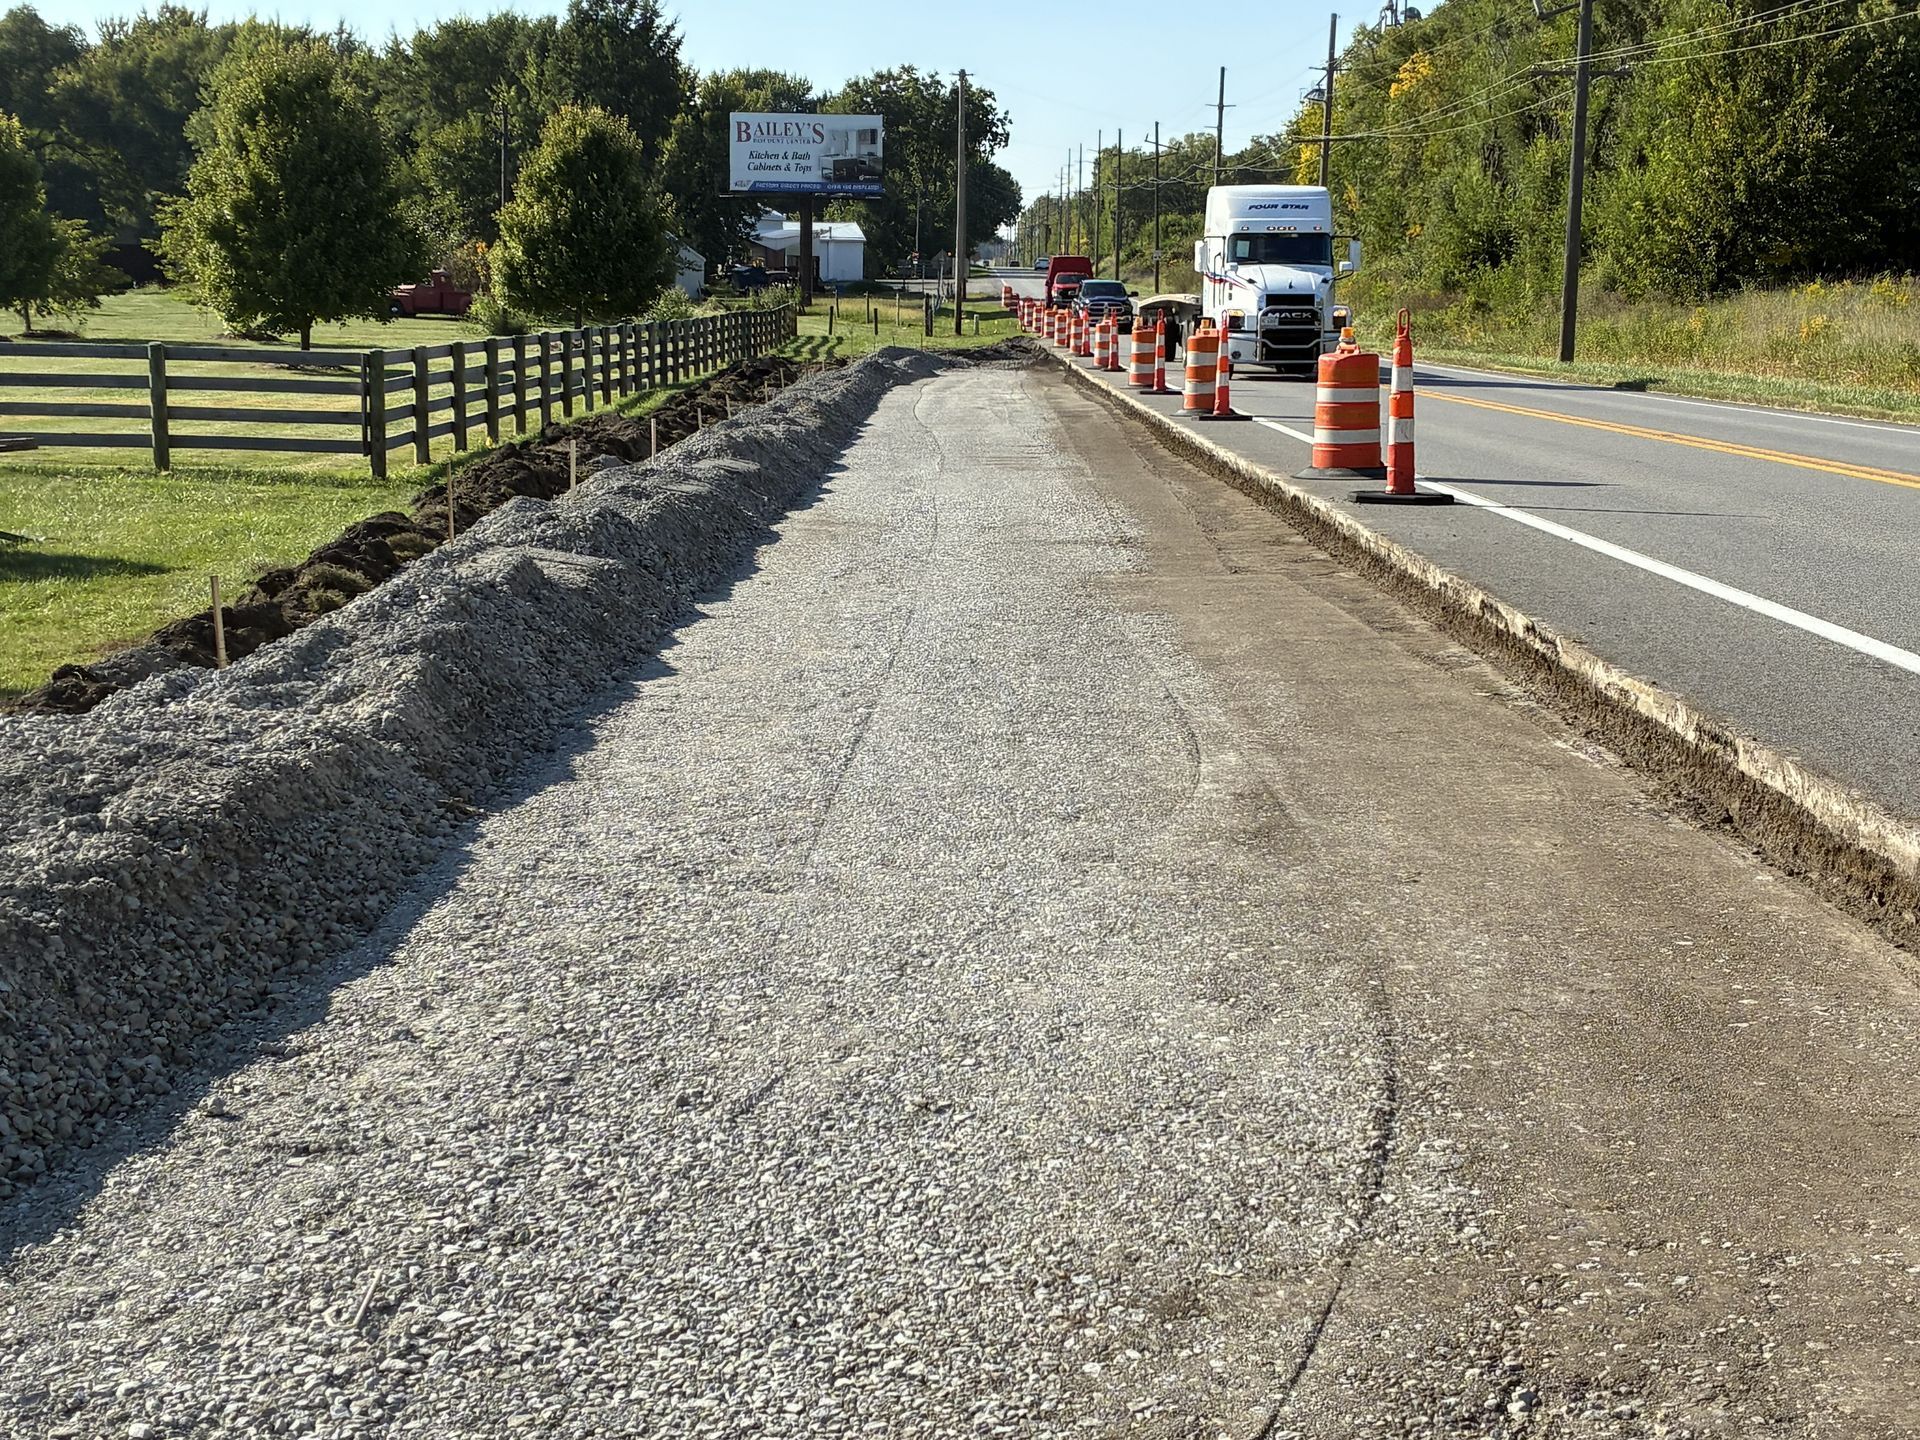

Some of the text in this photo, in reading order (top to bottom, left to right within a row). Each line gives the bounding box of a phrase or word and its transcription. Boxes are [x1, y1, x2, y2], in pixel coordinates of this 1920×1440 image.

[736, 121, 825, 144] BAILEY'S
[749, 150, 811, 160] Kitchen & Bath
[747, 161, 812, 174] Cabinets & Tops
